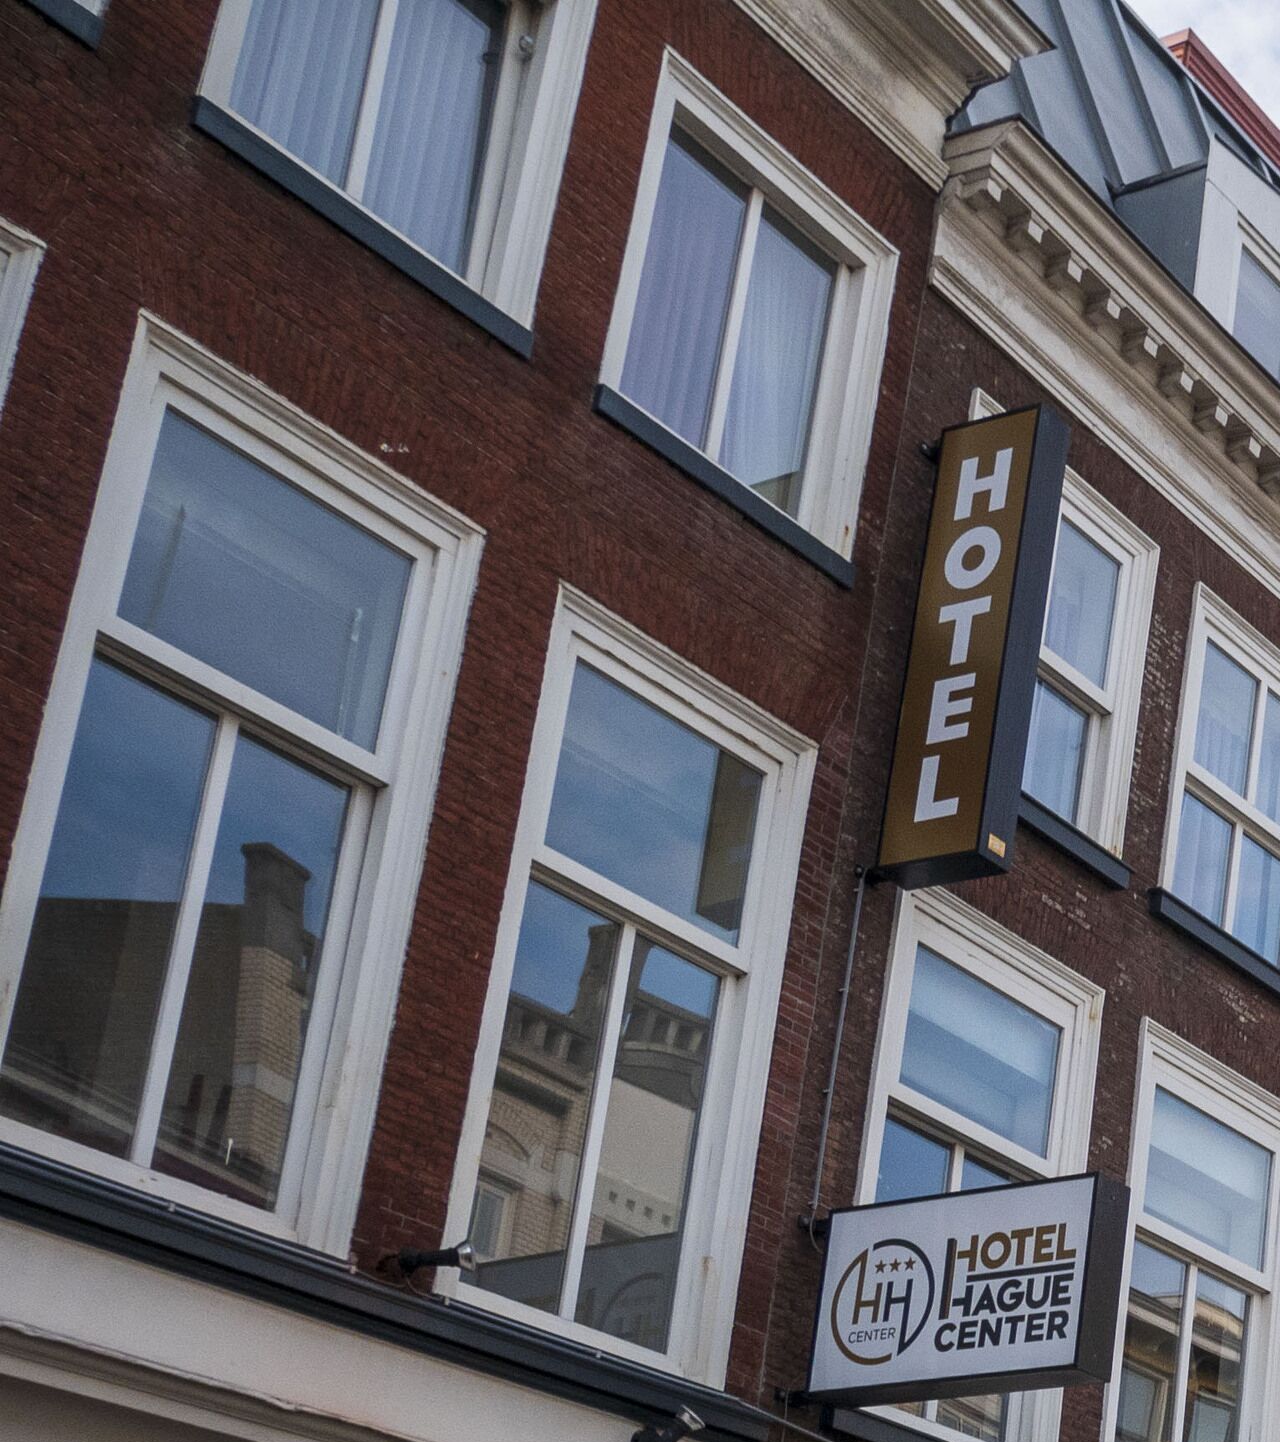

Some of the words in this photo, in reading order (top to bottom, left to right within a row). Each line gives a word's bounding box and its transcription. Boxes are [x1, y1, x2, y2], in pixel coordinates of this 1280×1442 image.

[914, 447, 1013, 823] HOTEL
[945, 1223, 1077, 1272] HOTEL
[940, 1273, 1075, 1319] HAGUE
[848, 1327, 896, 1344] CENTER
[934, 1310, 1069, 1352] CENTER
